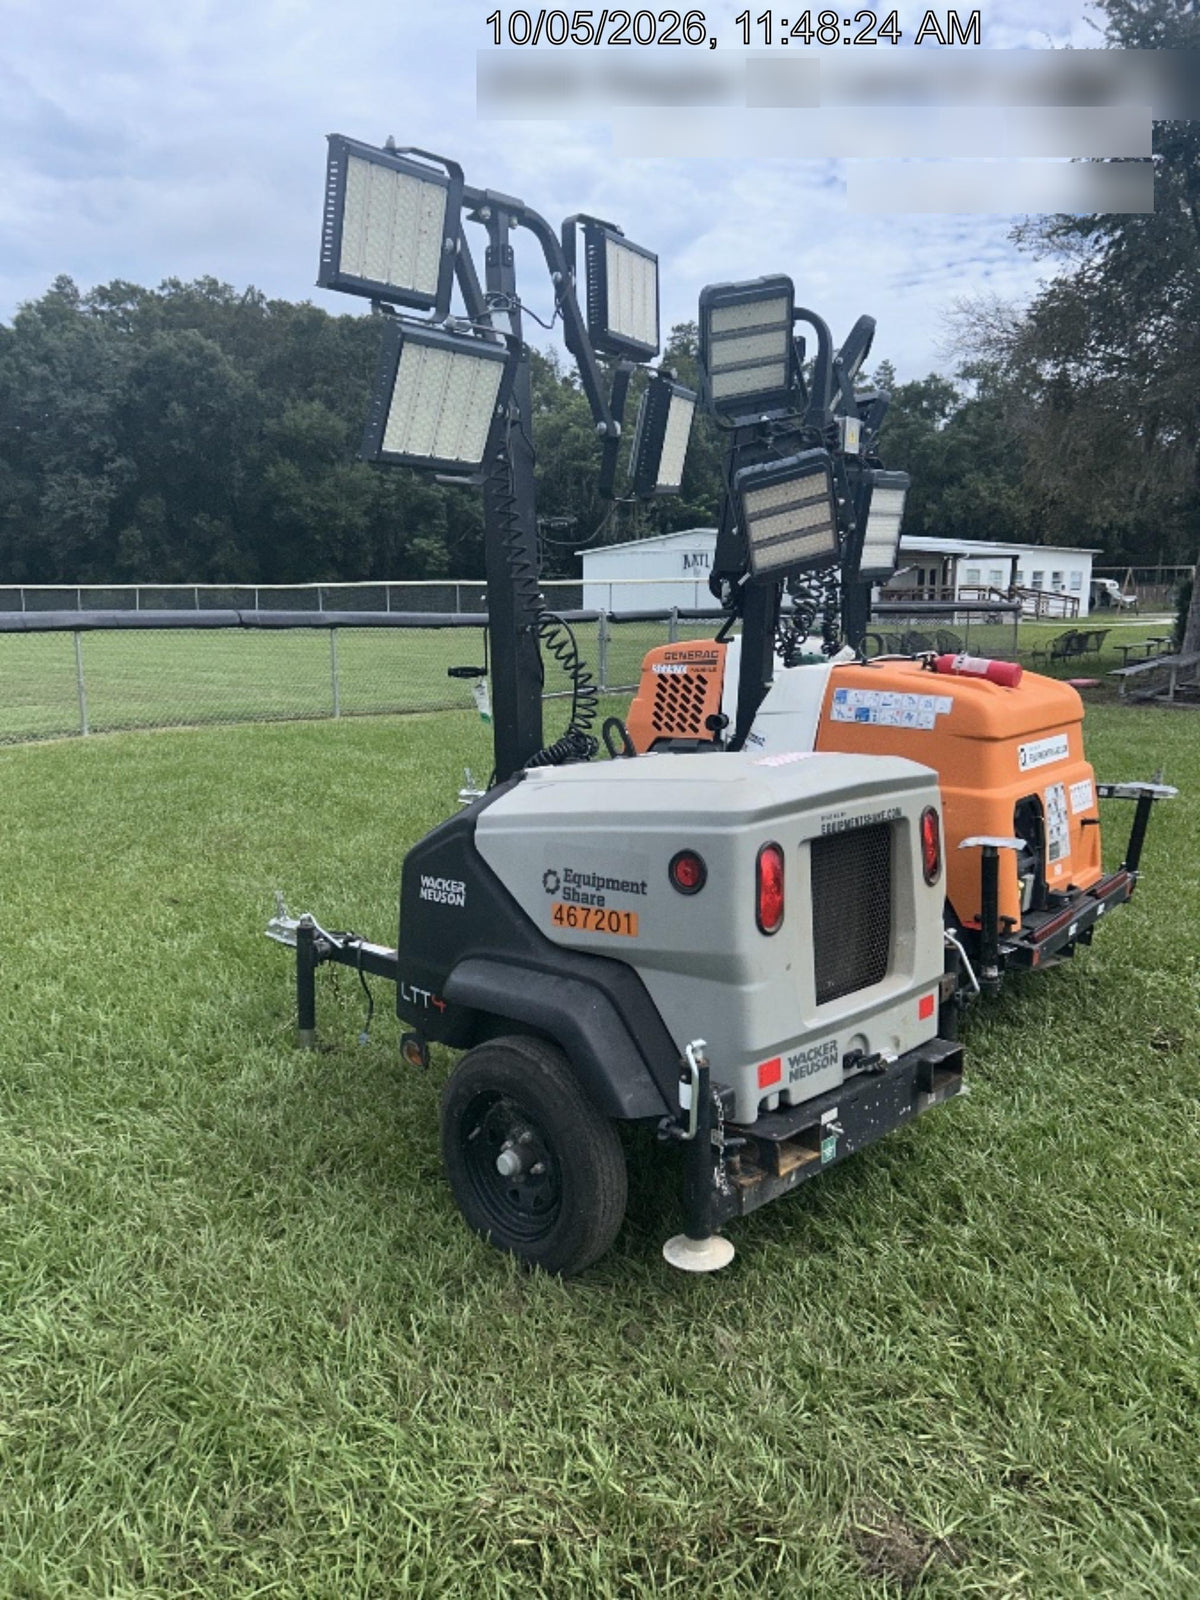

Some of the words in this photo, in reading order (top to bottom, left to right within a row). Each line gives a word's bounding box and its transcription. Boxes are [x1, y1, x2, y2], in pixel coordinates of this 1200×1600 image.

[664, 650, 719, 660] GENERAC
[420, 874, 467, 894] WACKER
[563, 868, 648, 896] Equipment
[419, 887, 466, 907] NEUSON
[562, 886, 606, 907] Share
[553, 904, 635, 934] 467201
[400, 981, 447, 1014] LTT4
[787, 1039, 838, 1069] WACKER
[788, 1052, 838, 1084] NEUSON
